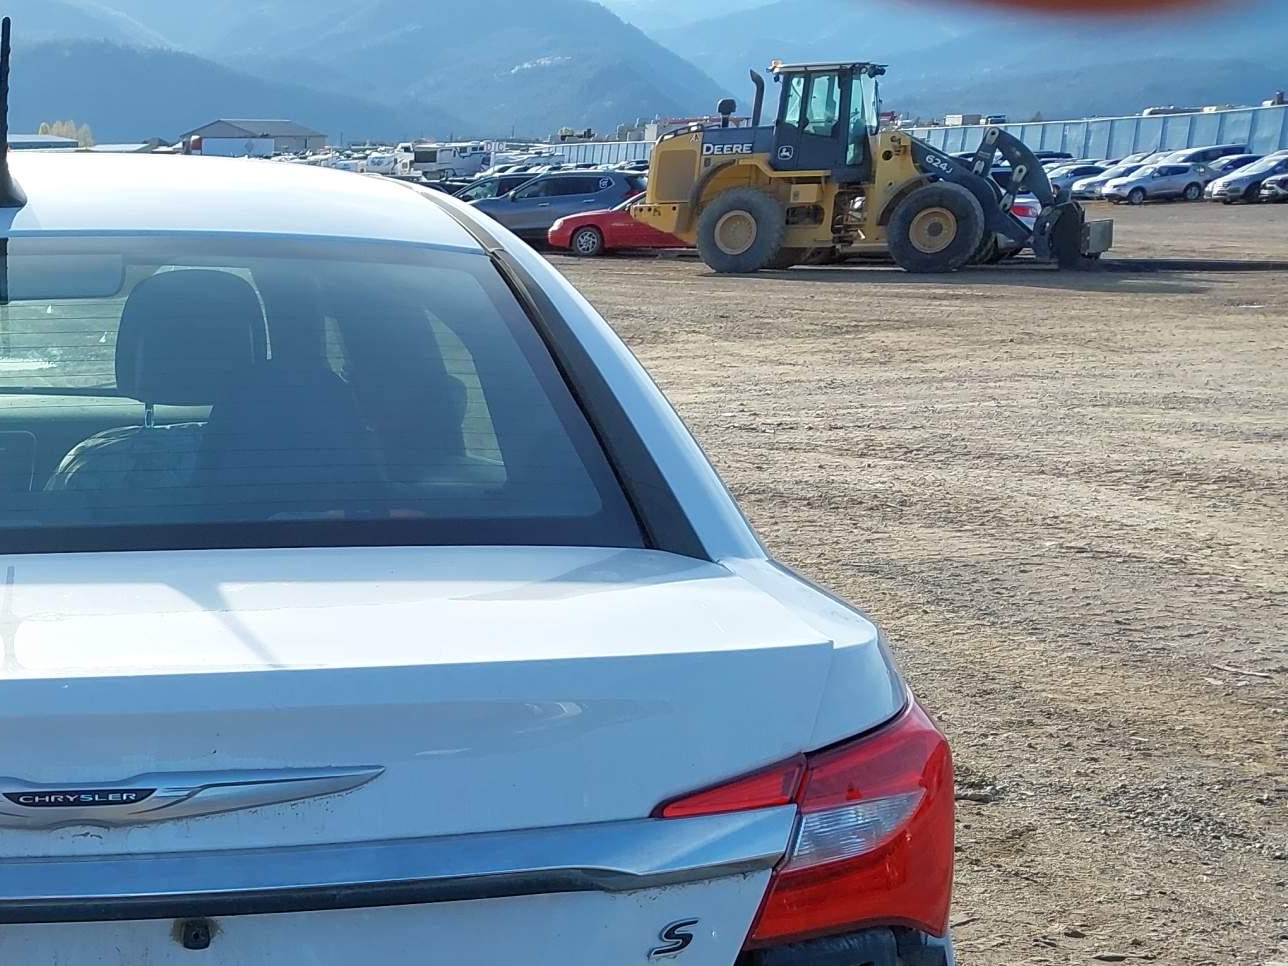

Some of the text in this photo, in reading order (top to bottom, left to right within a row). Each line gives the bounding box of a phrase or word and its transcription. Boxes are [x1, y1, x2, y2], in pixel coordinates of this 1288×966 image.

[702, 143, 753, 155] DEERE
[925, 154, 953, 174] 624J
[19, 793, 137, 803] CHRYSLER
[649, 917, 700, 958] S
